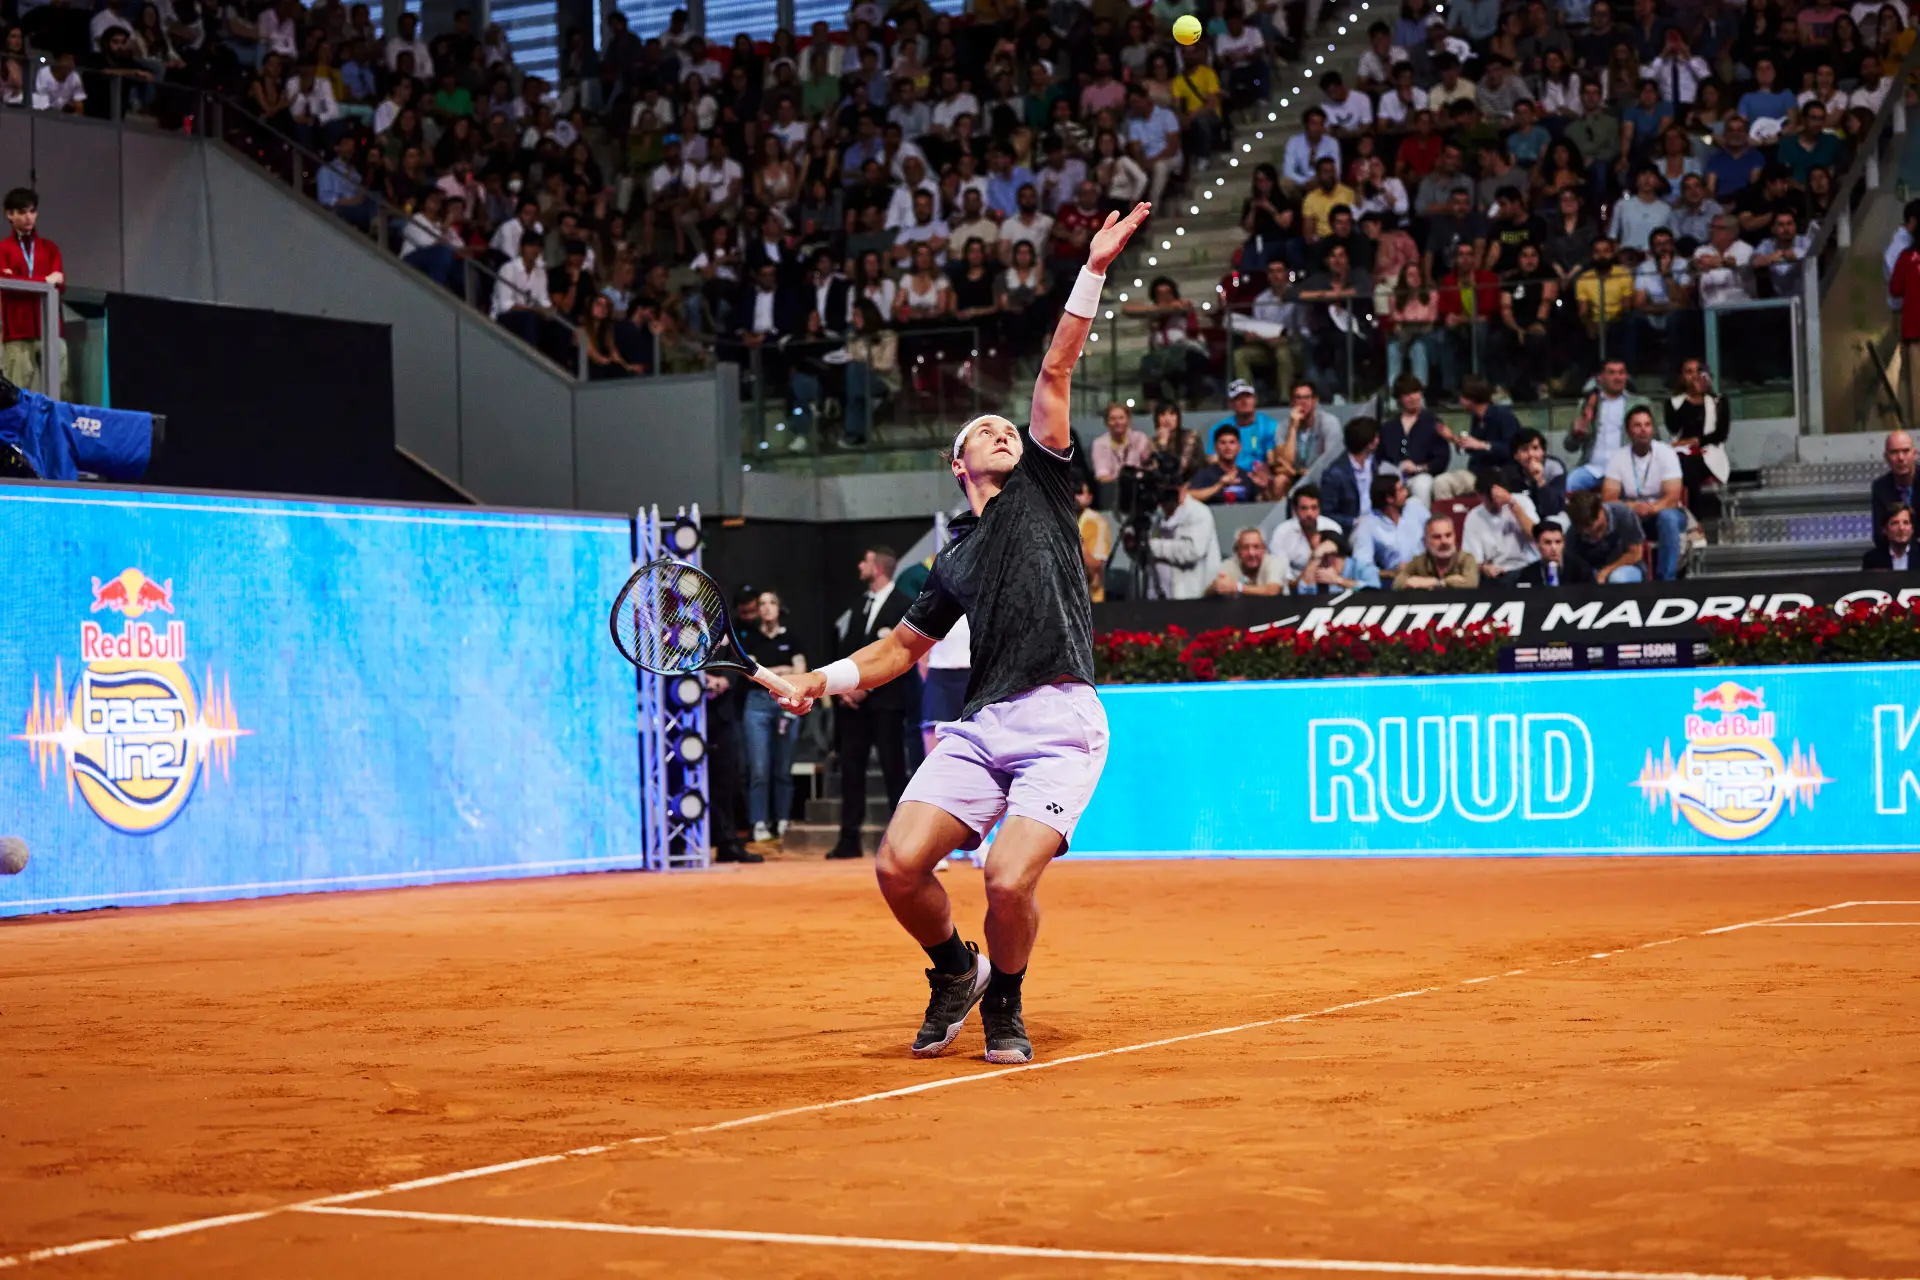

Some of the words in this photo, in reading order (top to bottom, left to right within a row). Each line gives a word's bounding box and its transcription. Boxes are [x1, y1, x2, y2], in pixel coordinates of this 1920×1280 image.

[71, 416, 102, 431] ATP
[1297, 601, 1526, 640] MUTUA
[1541, 593, 1815, 629] MADRID
[82, 621, 133, 660] Red
[136, 621, 185, 660] Bull
[82, 678, 180, 733] bass
[1686, 714, 1728, 739] Red
[1731, 712, 1774, 739] Bull
[105, 736, 181, 780] line
[1308, 712, 1594, 823] RUUD
[1686, 751, 1768, 781] bass
[1704, 782, 1768, 809] line
